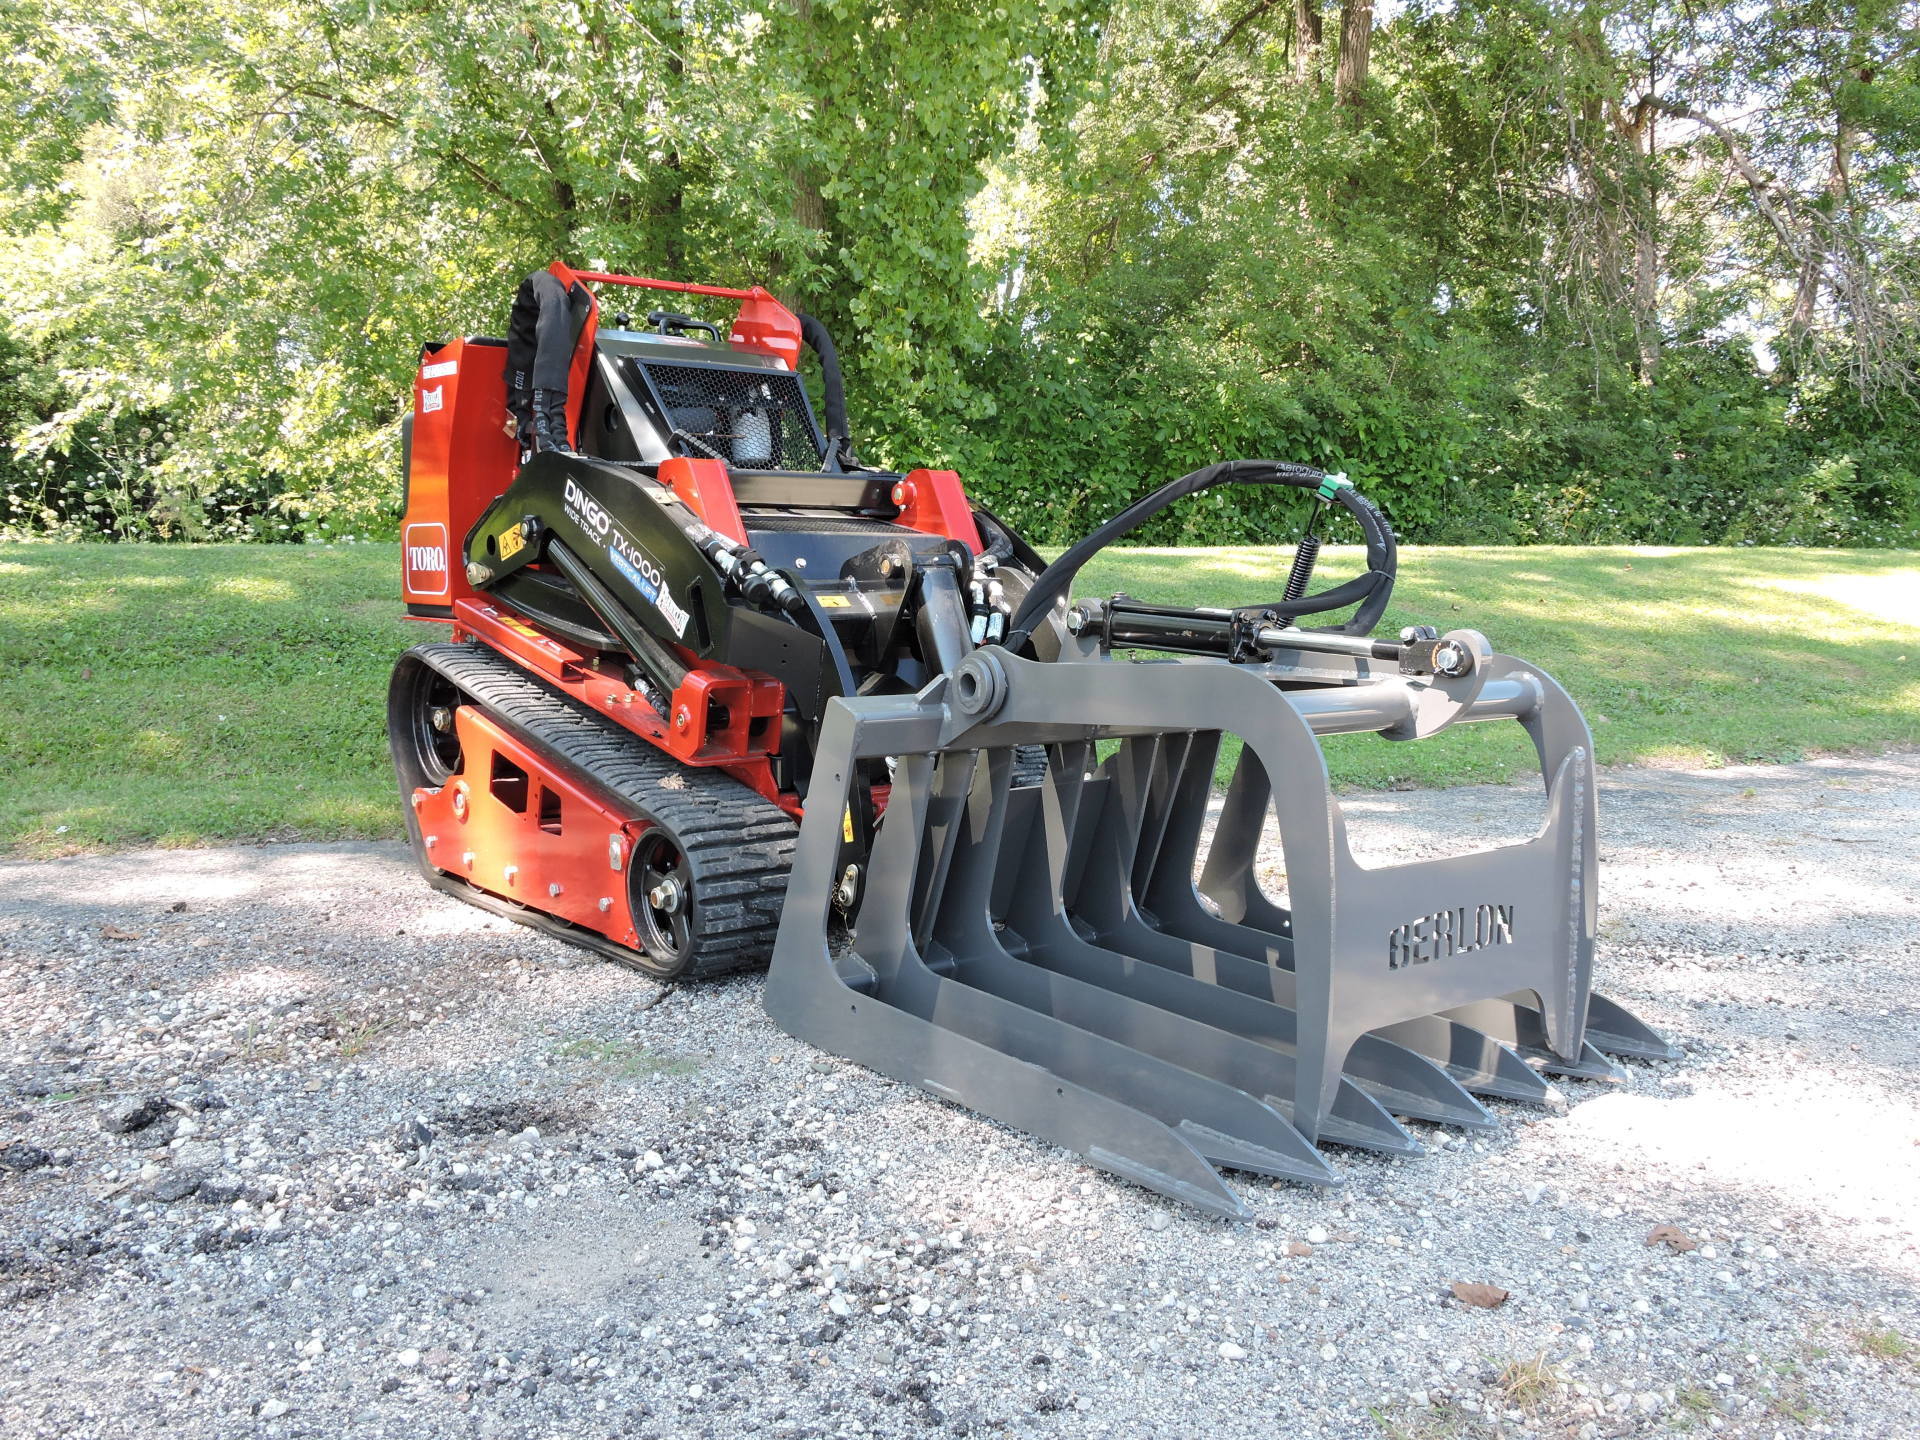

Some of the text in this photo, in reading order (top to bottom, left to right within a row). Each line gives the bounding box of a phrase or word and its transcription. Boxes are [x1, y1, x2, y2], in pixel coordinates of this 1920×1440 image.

[564, 478, 610, 535] DINGO
[564, 503, 602, 547] WIDE TRACK
[409, 546, 445, 571] TORO
[1389, 904, 1513, 970] BERLON
